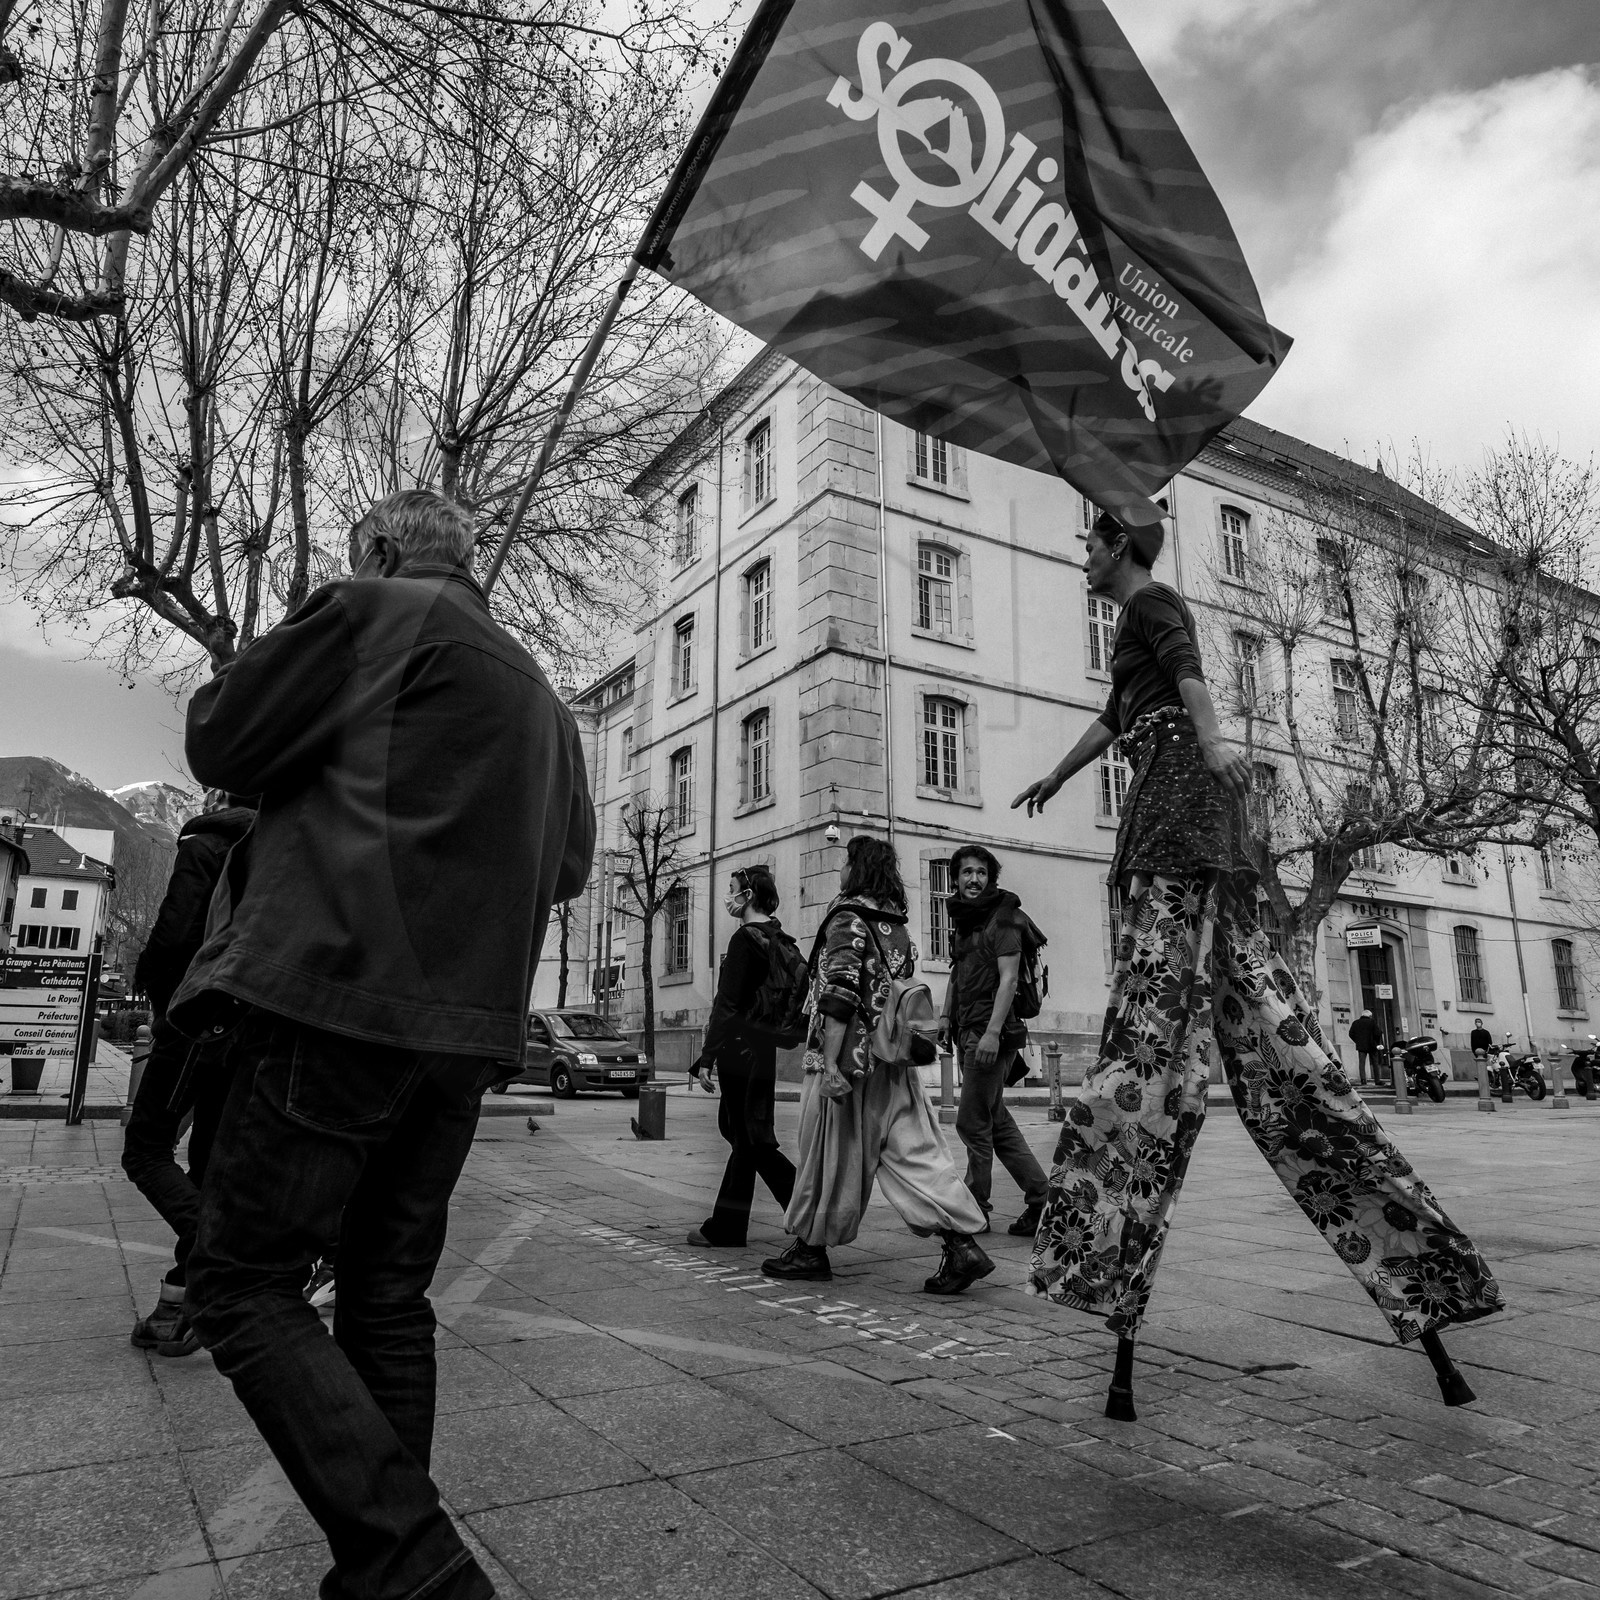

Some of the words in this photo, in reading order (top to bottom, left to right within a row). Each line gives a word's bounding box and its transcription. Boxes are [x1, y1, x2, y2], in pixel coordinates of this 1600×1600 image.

[1118, 262, 1181, 320] Union
[1106, 291, 1194, 364] syndicale
[1352, 903, 1398, 920] POLICE
[6, 957, 32, 967] Grange
[39, 959, 51, 967] Les
[52, 959, 85, 968] Pénitents
[41, 976, 83, 986] Cathédrale
[47, 994, 56, 1002] Le
[58, 994, 81, 1005] Royal
[37, 1011, 79, 1021] Préfecture
[14, 1028, 43, 1038] Conseil
[44, 1029, 77, 1039] Général
[12, 1047, 33, 1056] alais
[35, 1047, 45, 1056] de
[47, 1047, 75, 1056] Justice
